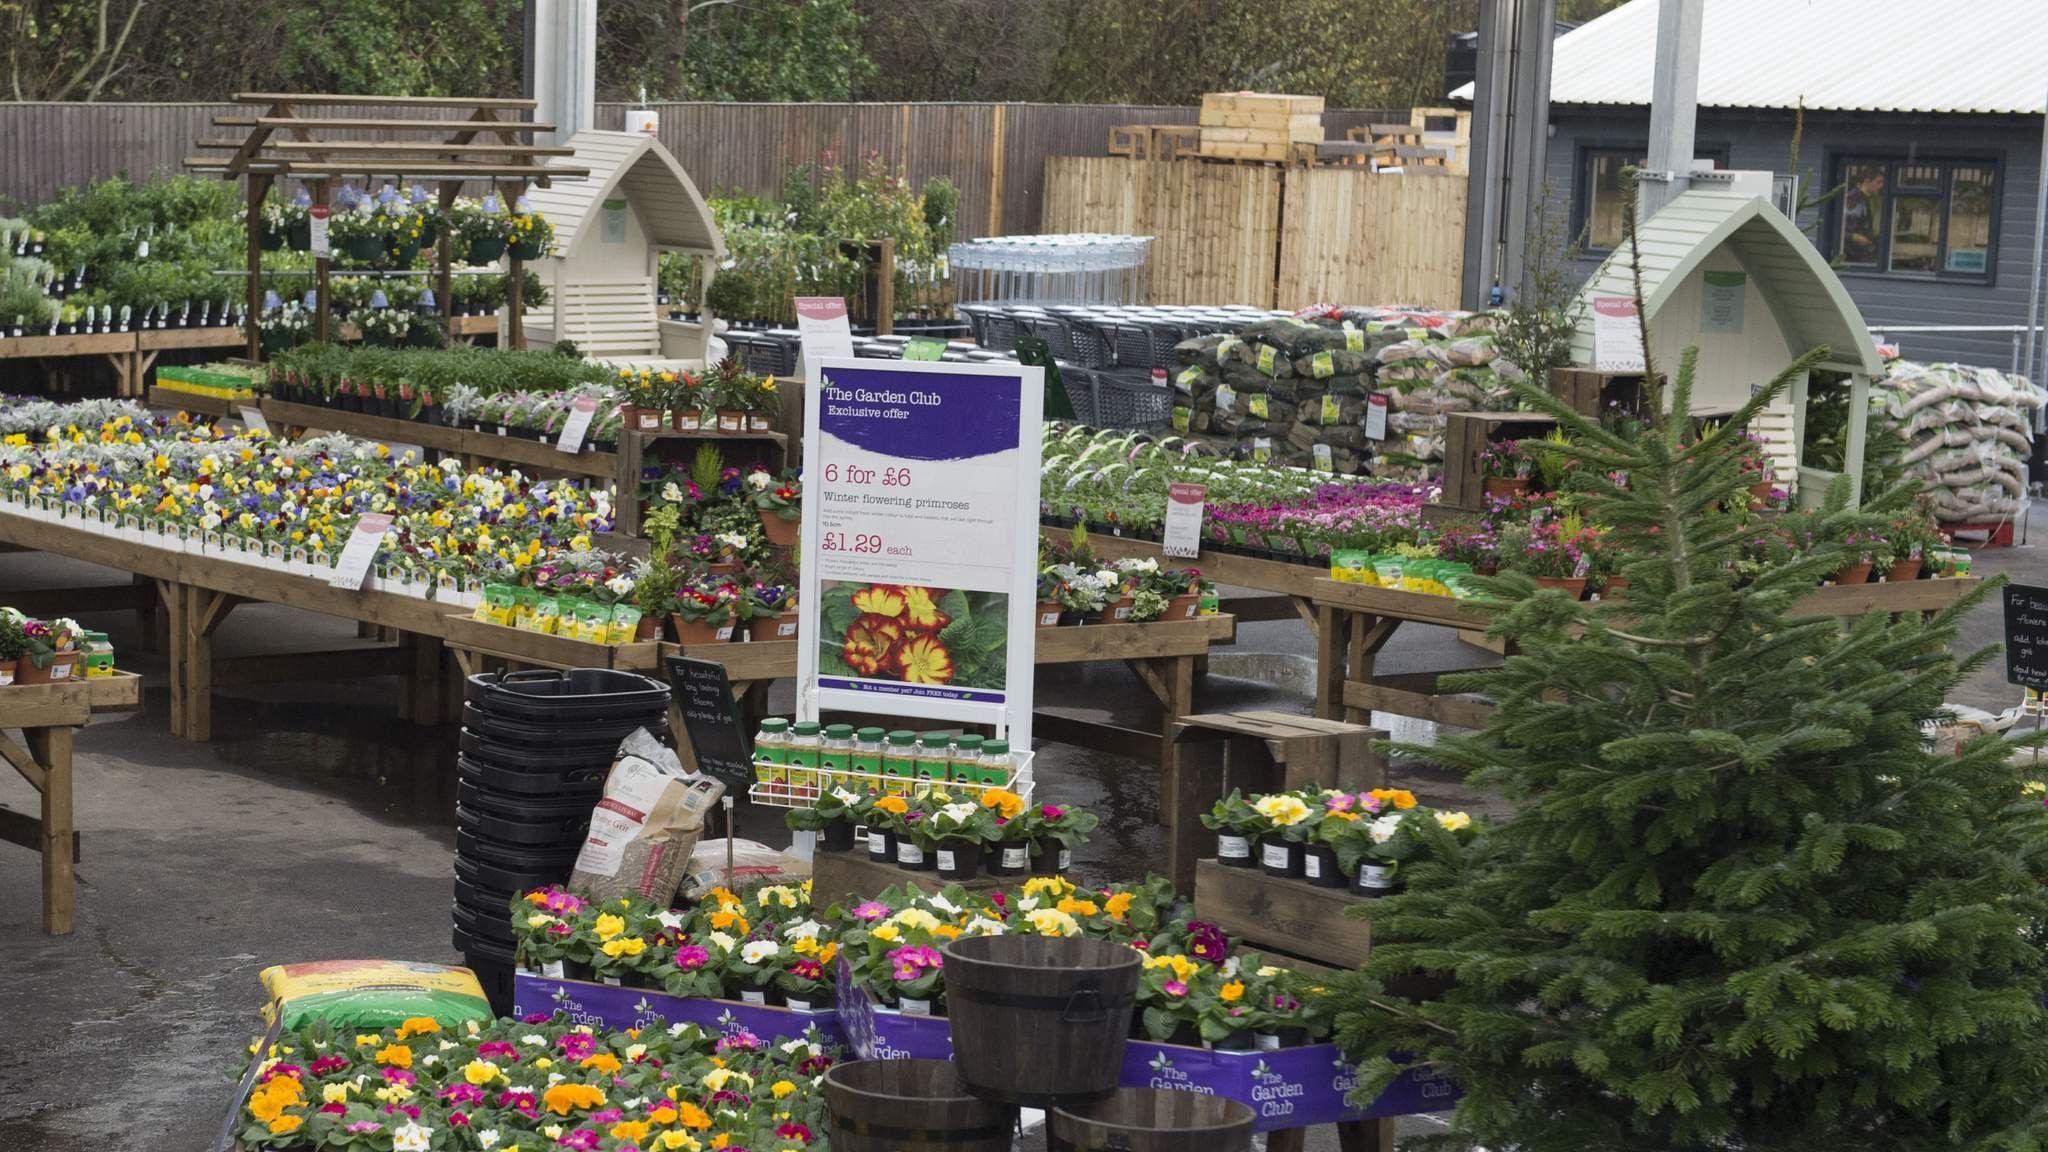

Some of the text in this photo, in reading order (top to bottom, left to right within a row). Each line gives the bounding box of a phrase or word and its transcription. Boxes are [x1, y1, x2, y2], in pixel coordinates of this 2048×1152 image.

[826, 387, 942, 406] The Garden Club
[828, 405, 910, 419] Exclusive offer
[825, 463, 911, 487] 6 for £6
[823, 491, 970, 511] Winter flowering primroses
[822, 531, 912, 556] £1.29 each
[2011, 594, 2025, 606] For
[562, 1000, 582, 1011] The
[553, 1008, 604, 1027] rden
[728, 1022, 749, 1033] The
[873, 1045, 911, 1060] rden
[1162, 1066, 1188, 1080] The
[1263, 1073, 1282, 1084] The
[1150, 1077, 1215, 1096] Garden
[1333, 1075, 1358, 1091] Gar
[1421, 1082, 1452, 1098] Club
[1252, 1082, 1304, 1101] Garden
[1262, 1099, 1294, 1117] Club
